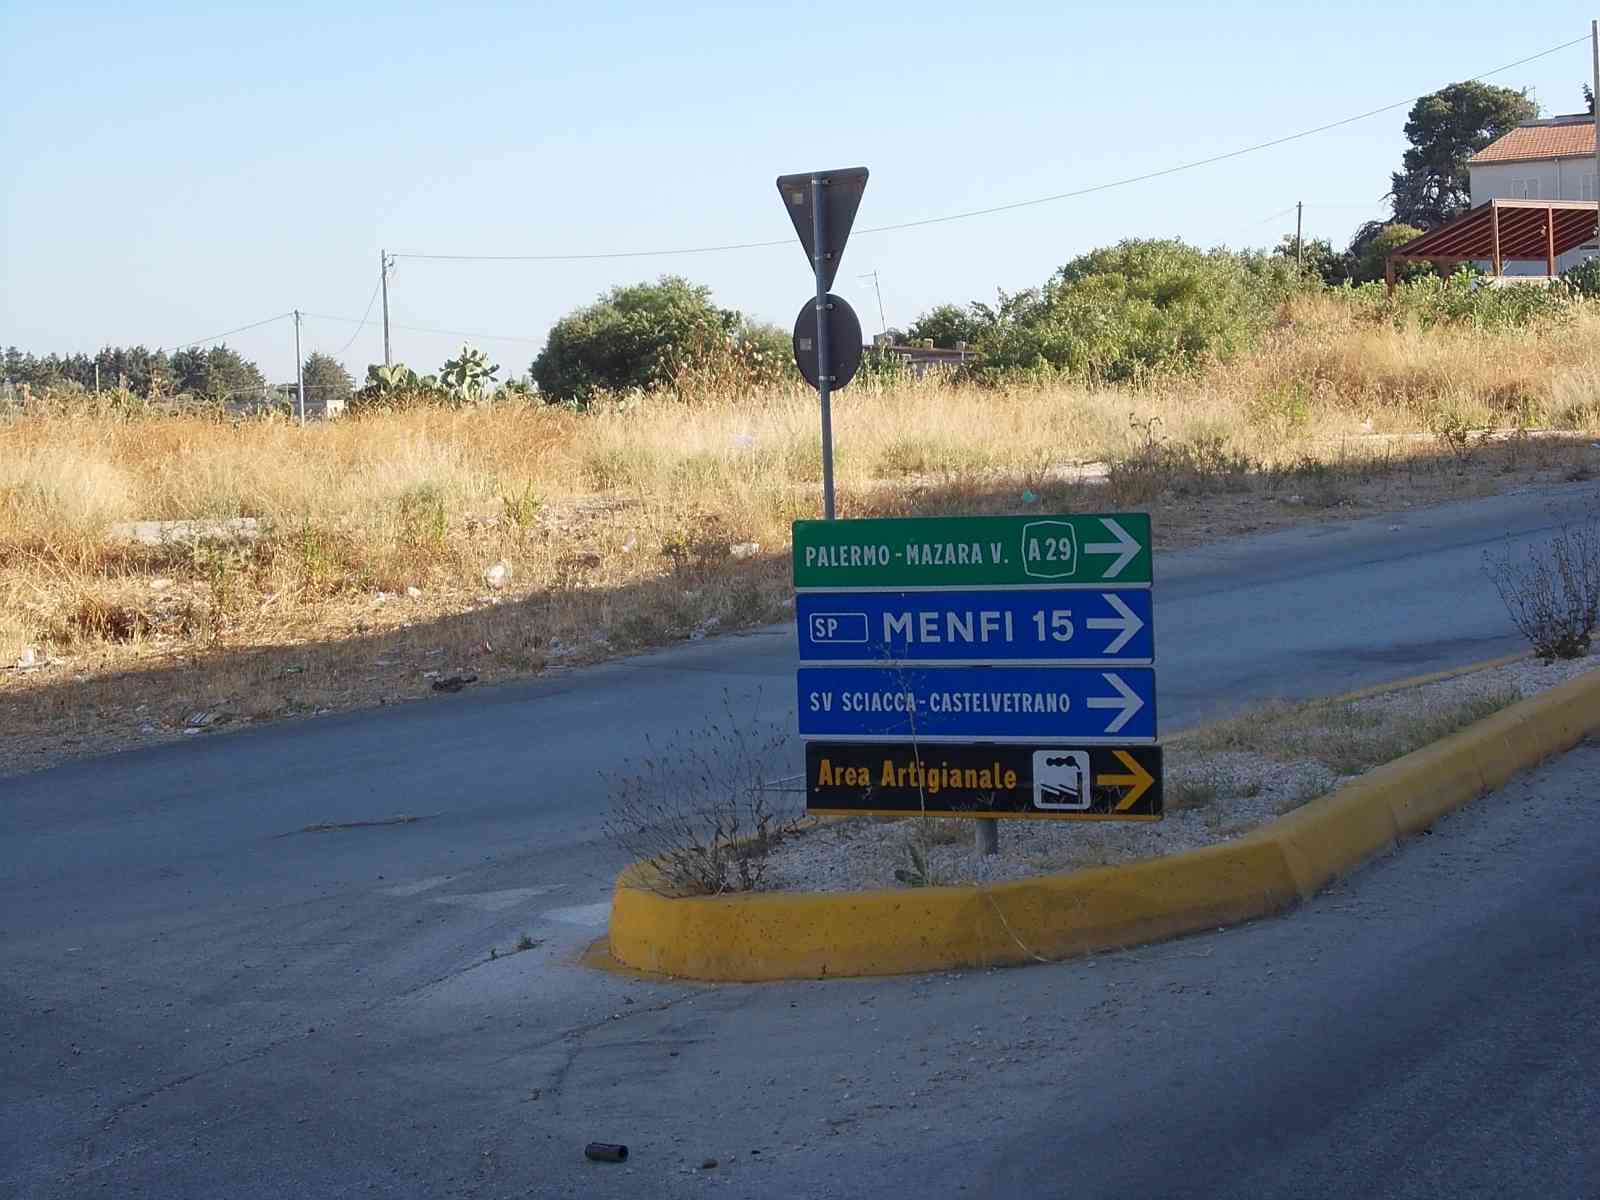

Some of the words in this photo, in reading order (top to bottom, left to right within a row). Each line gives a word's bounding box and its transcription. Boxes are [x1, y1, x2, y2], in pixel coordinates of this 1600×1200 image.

[991, 543, 1009, 565] V.
[1028, 541, 1041, 561] A
[1045, 538, 1072, 561] 29
[815, 618, 839, 638] SP
[883, 611, 1014, 643] MENFI
[1032, 610, 1074, 642] 15
[809, 693, 832, 711] SV
[818, 759, 871, 786] Area
[881, 759, 1017, 793] Artigianale
